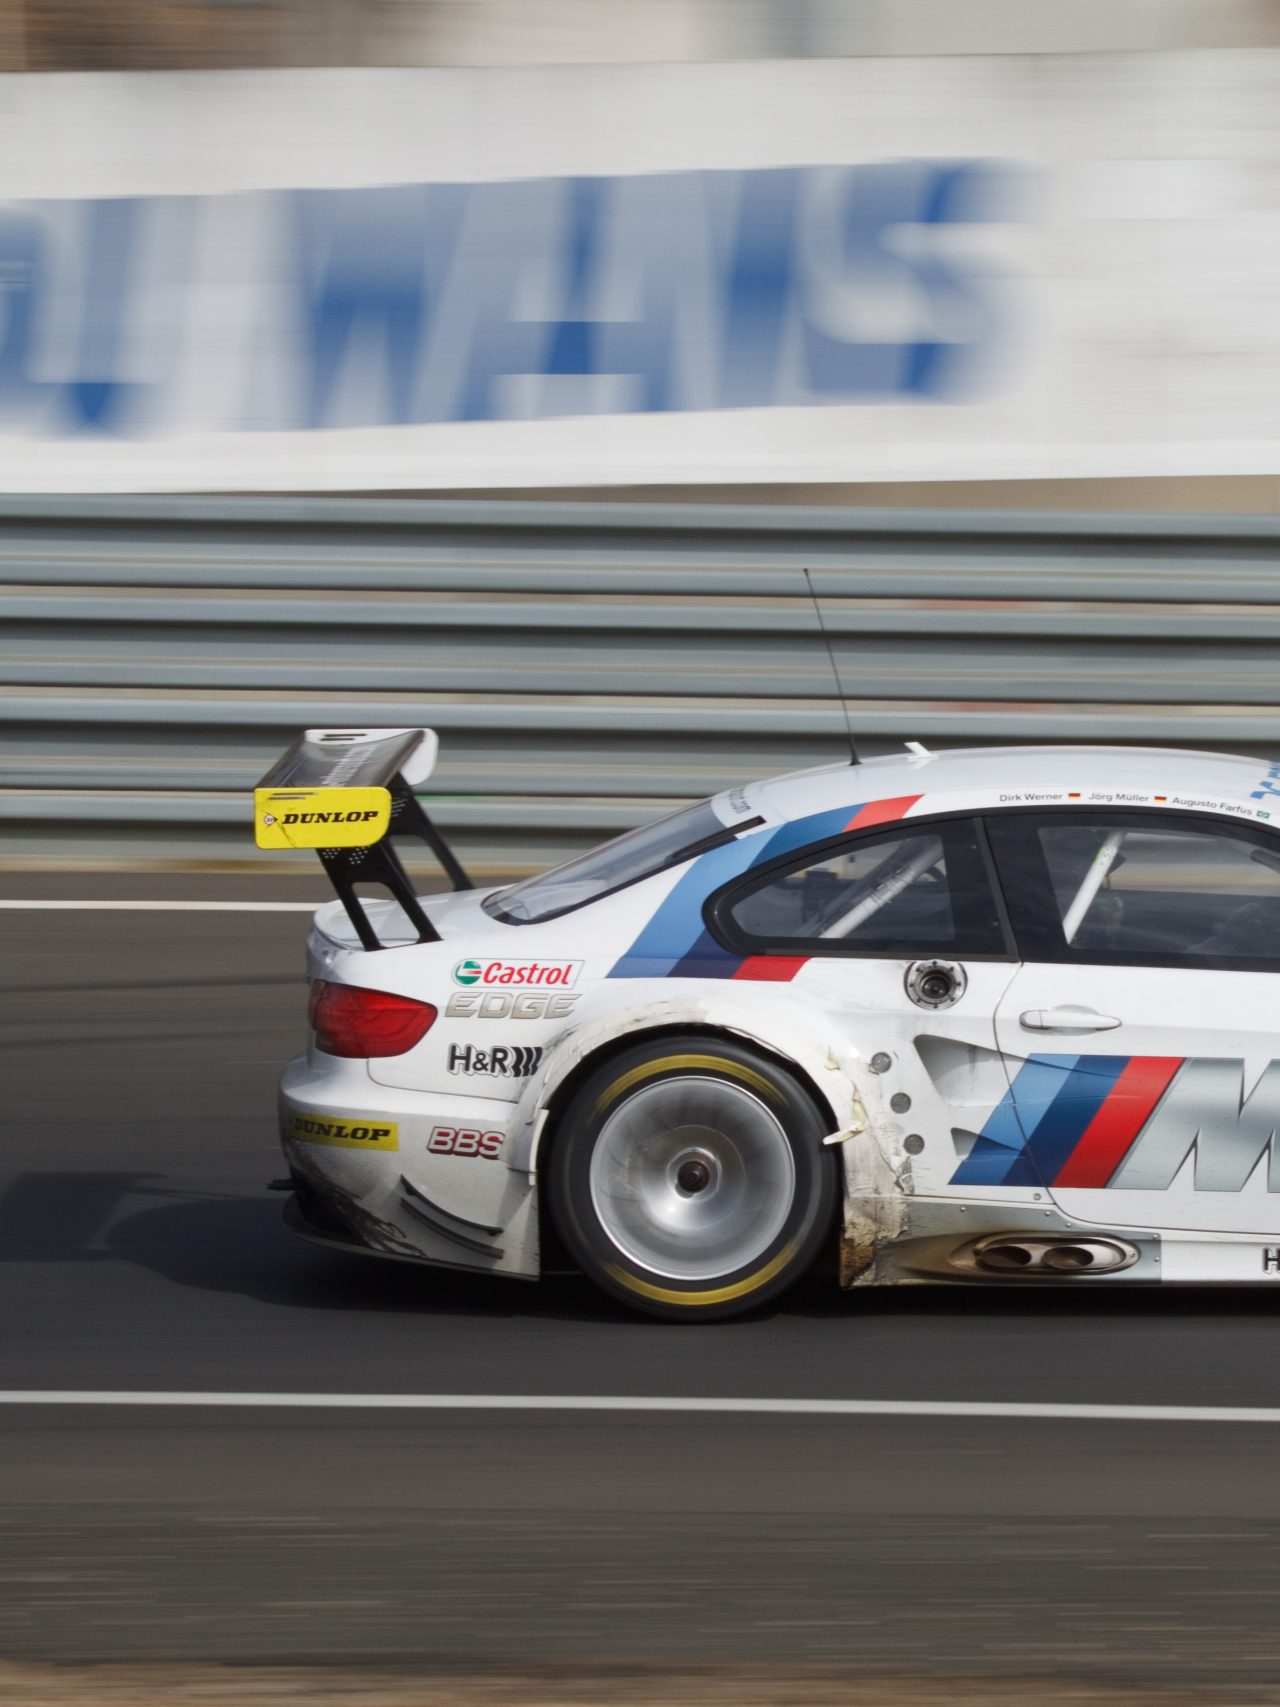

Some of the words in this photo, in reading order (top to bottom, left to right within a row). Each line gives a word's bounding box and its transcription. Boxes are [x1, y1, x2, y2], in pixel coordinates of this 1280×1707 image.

[1000, 793, 1022, 802] Dirk
[1025, 792, 1063, 801] Werner
[1088, 792, 1113, 802] Jörg
[1116, 793, 1150, 802] Müller
[1172, 796, 1218, 809] Augusto
[1220, 803, 1253, 816] Farfus
[281, 810, 380, 825] DUNLOP
[482, 961, 574, 986] Castrol
[443, 991, 584, 1020] EDGE
[449, 1044, 511, 1076] H&R
[293, 1117, 392, 1141] DUNLOP
[427, 1125, 506, 1160] BBS
